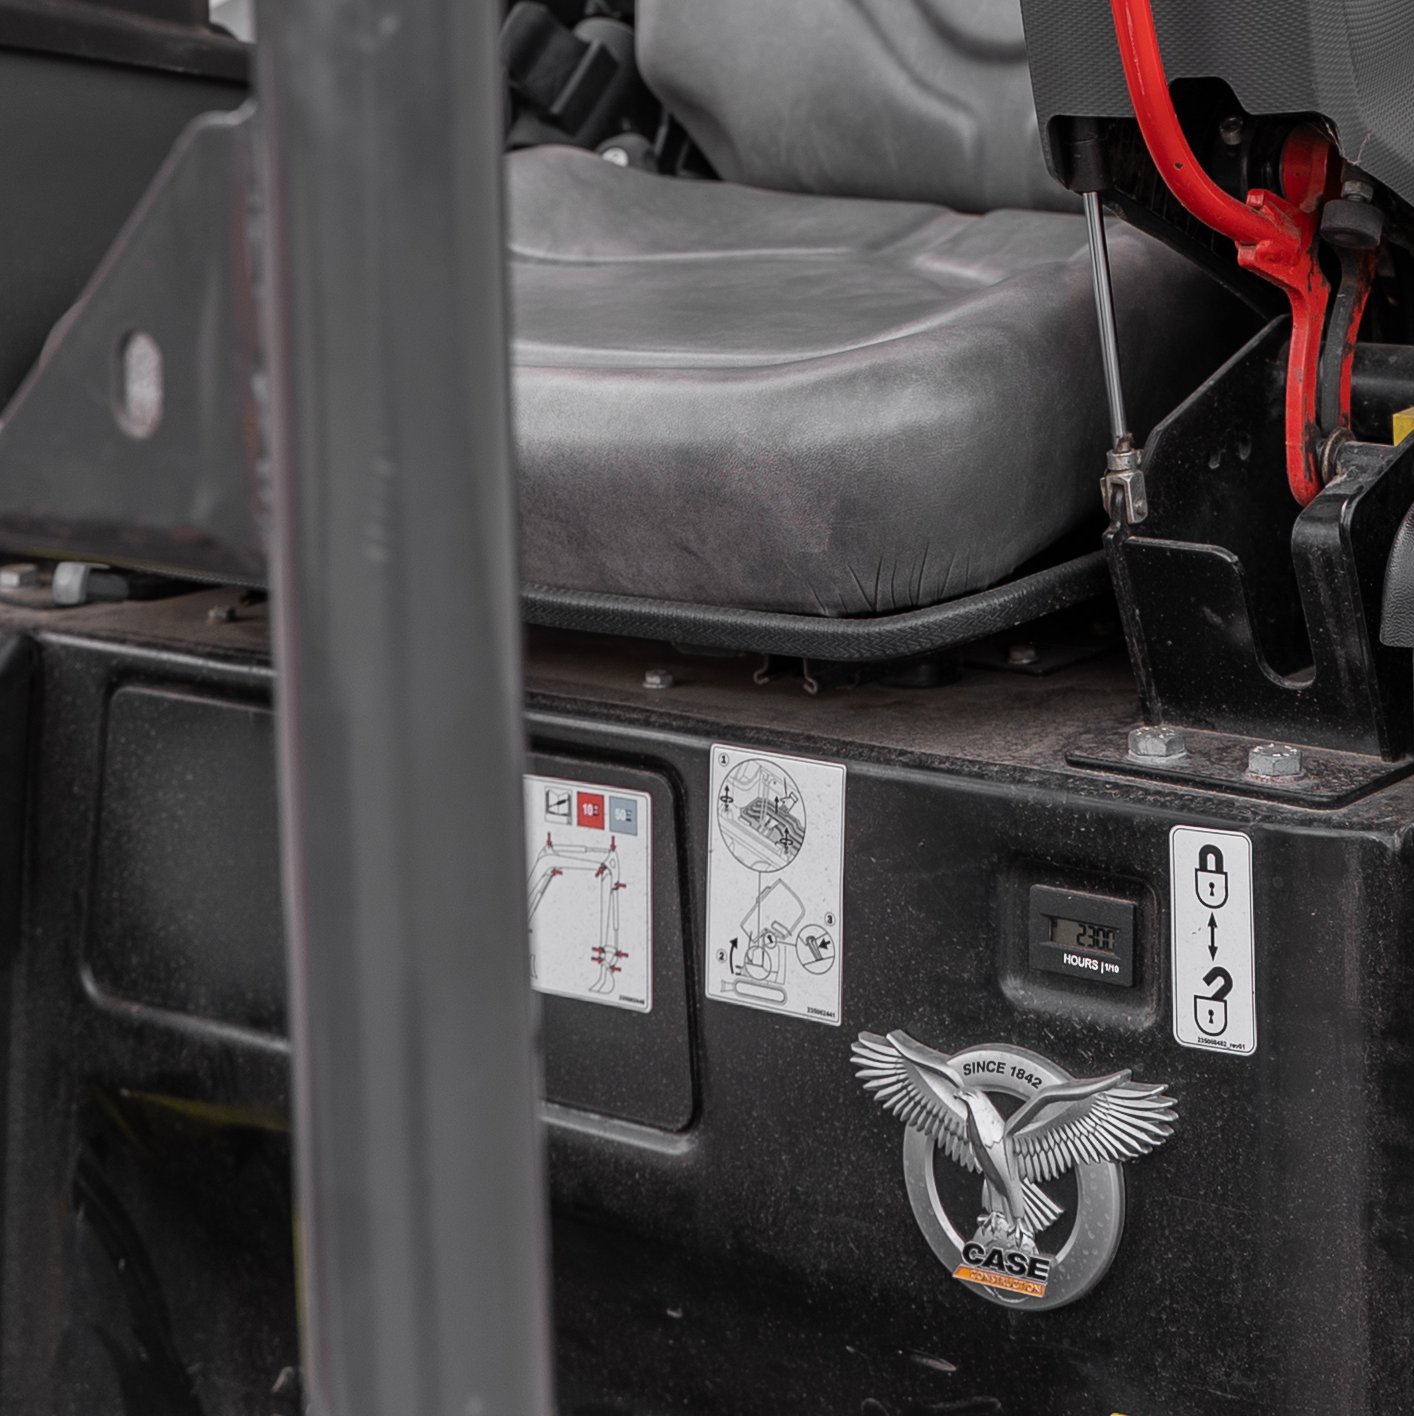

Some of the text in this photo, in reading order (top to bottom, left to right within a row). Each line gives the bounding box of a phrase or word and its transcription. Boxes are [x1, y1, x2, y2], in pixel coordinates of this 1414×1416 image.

[1064, 953, 1098, 970] HOURS
[963, 1061, 1043, 1089] SINCE 1842
[962, 1241, 1050, 1281] CASE
[970, 1270, 1041, 1293] CONSTRUCTION
